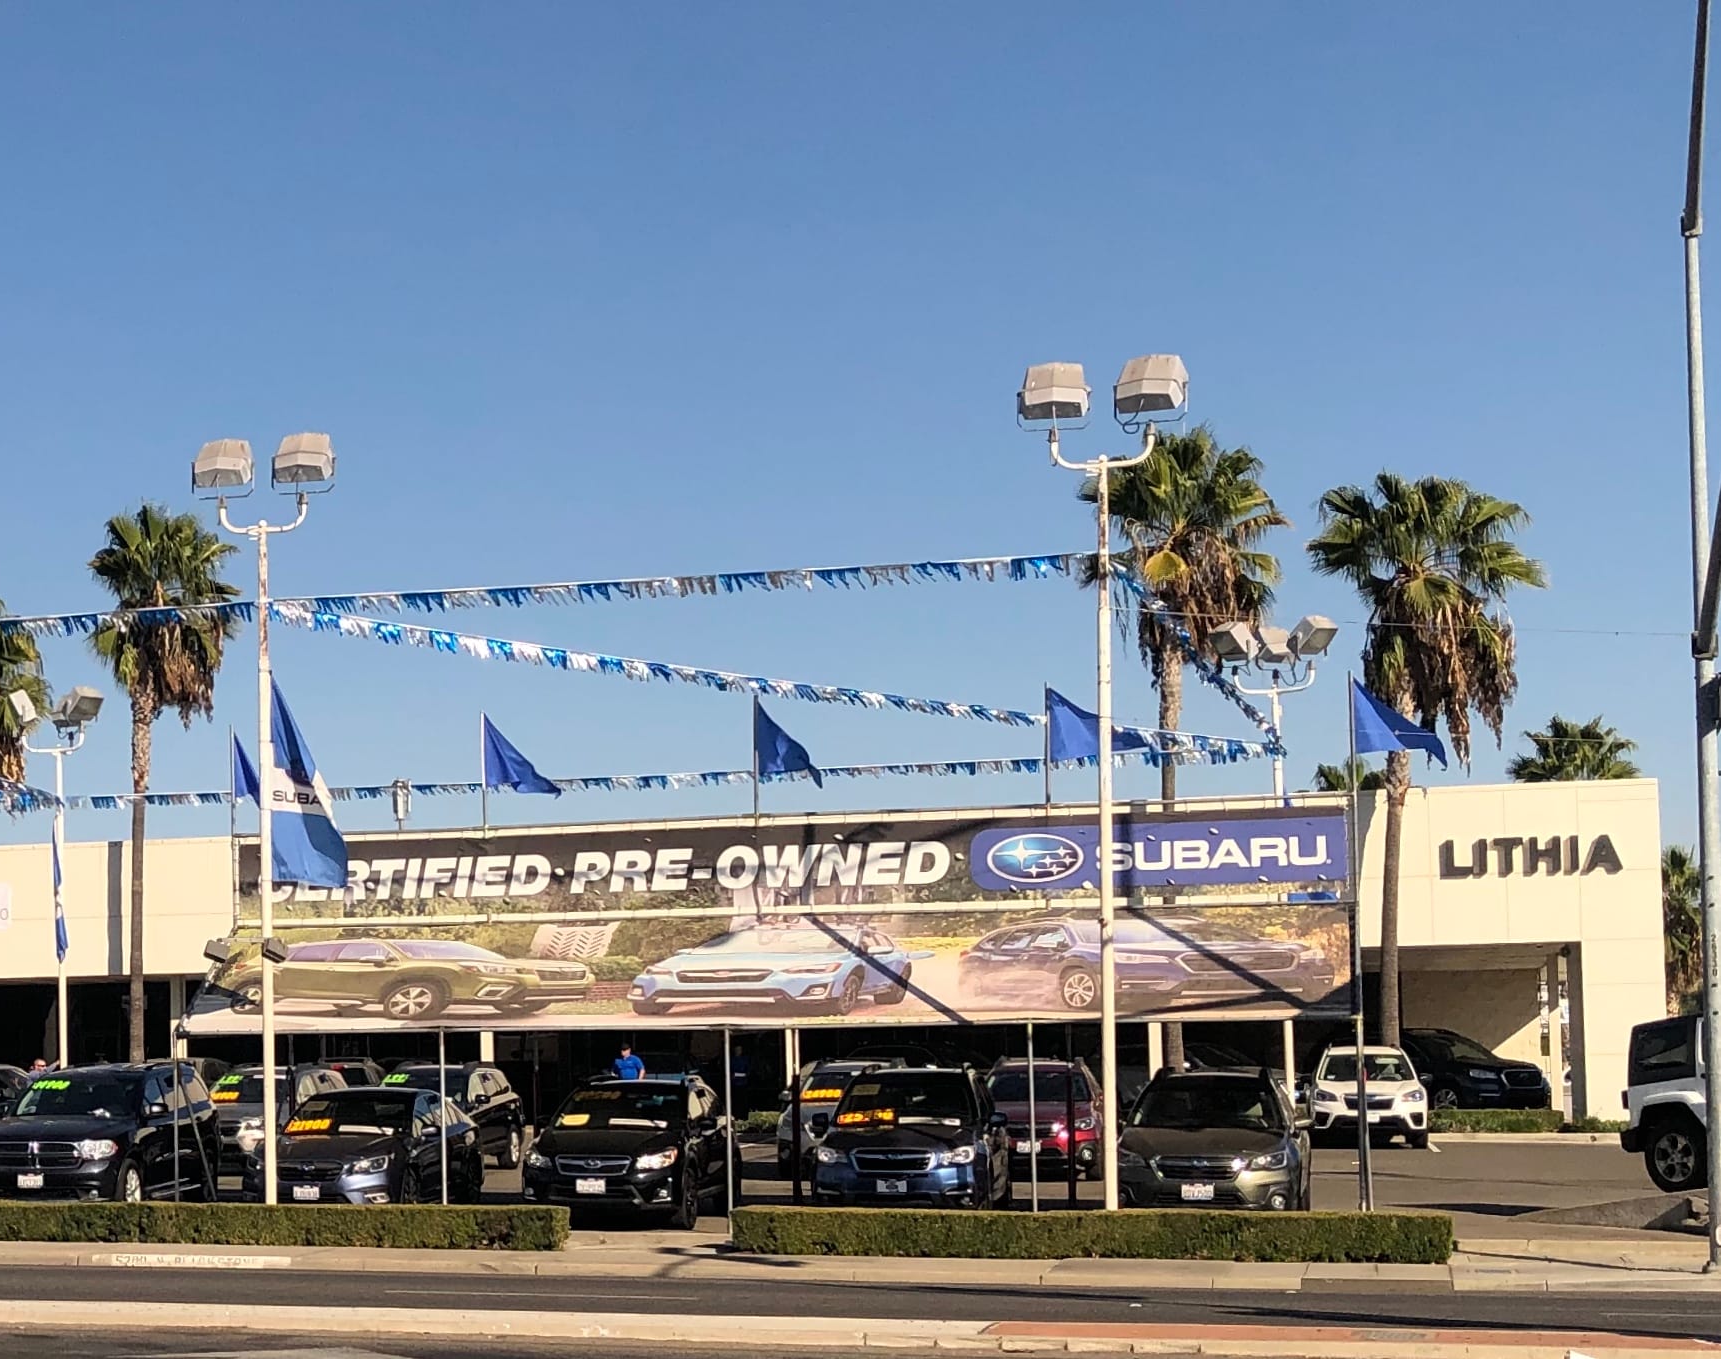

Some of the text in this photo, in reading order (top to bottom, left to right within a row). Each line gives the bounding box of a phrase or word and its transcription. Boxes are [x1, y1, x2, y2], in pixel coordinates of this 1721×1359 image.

[569, 840, 951, 894] PRE-OWNED
[1095, 834, 1328, 873] SUBARU
[1438, 833, 1624, 881] LITHIA
